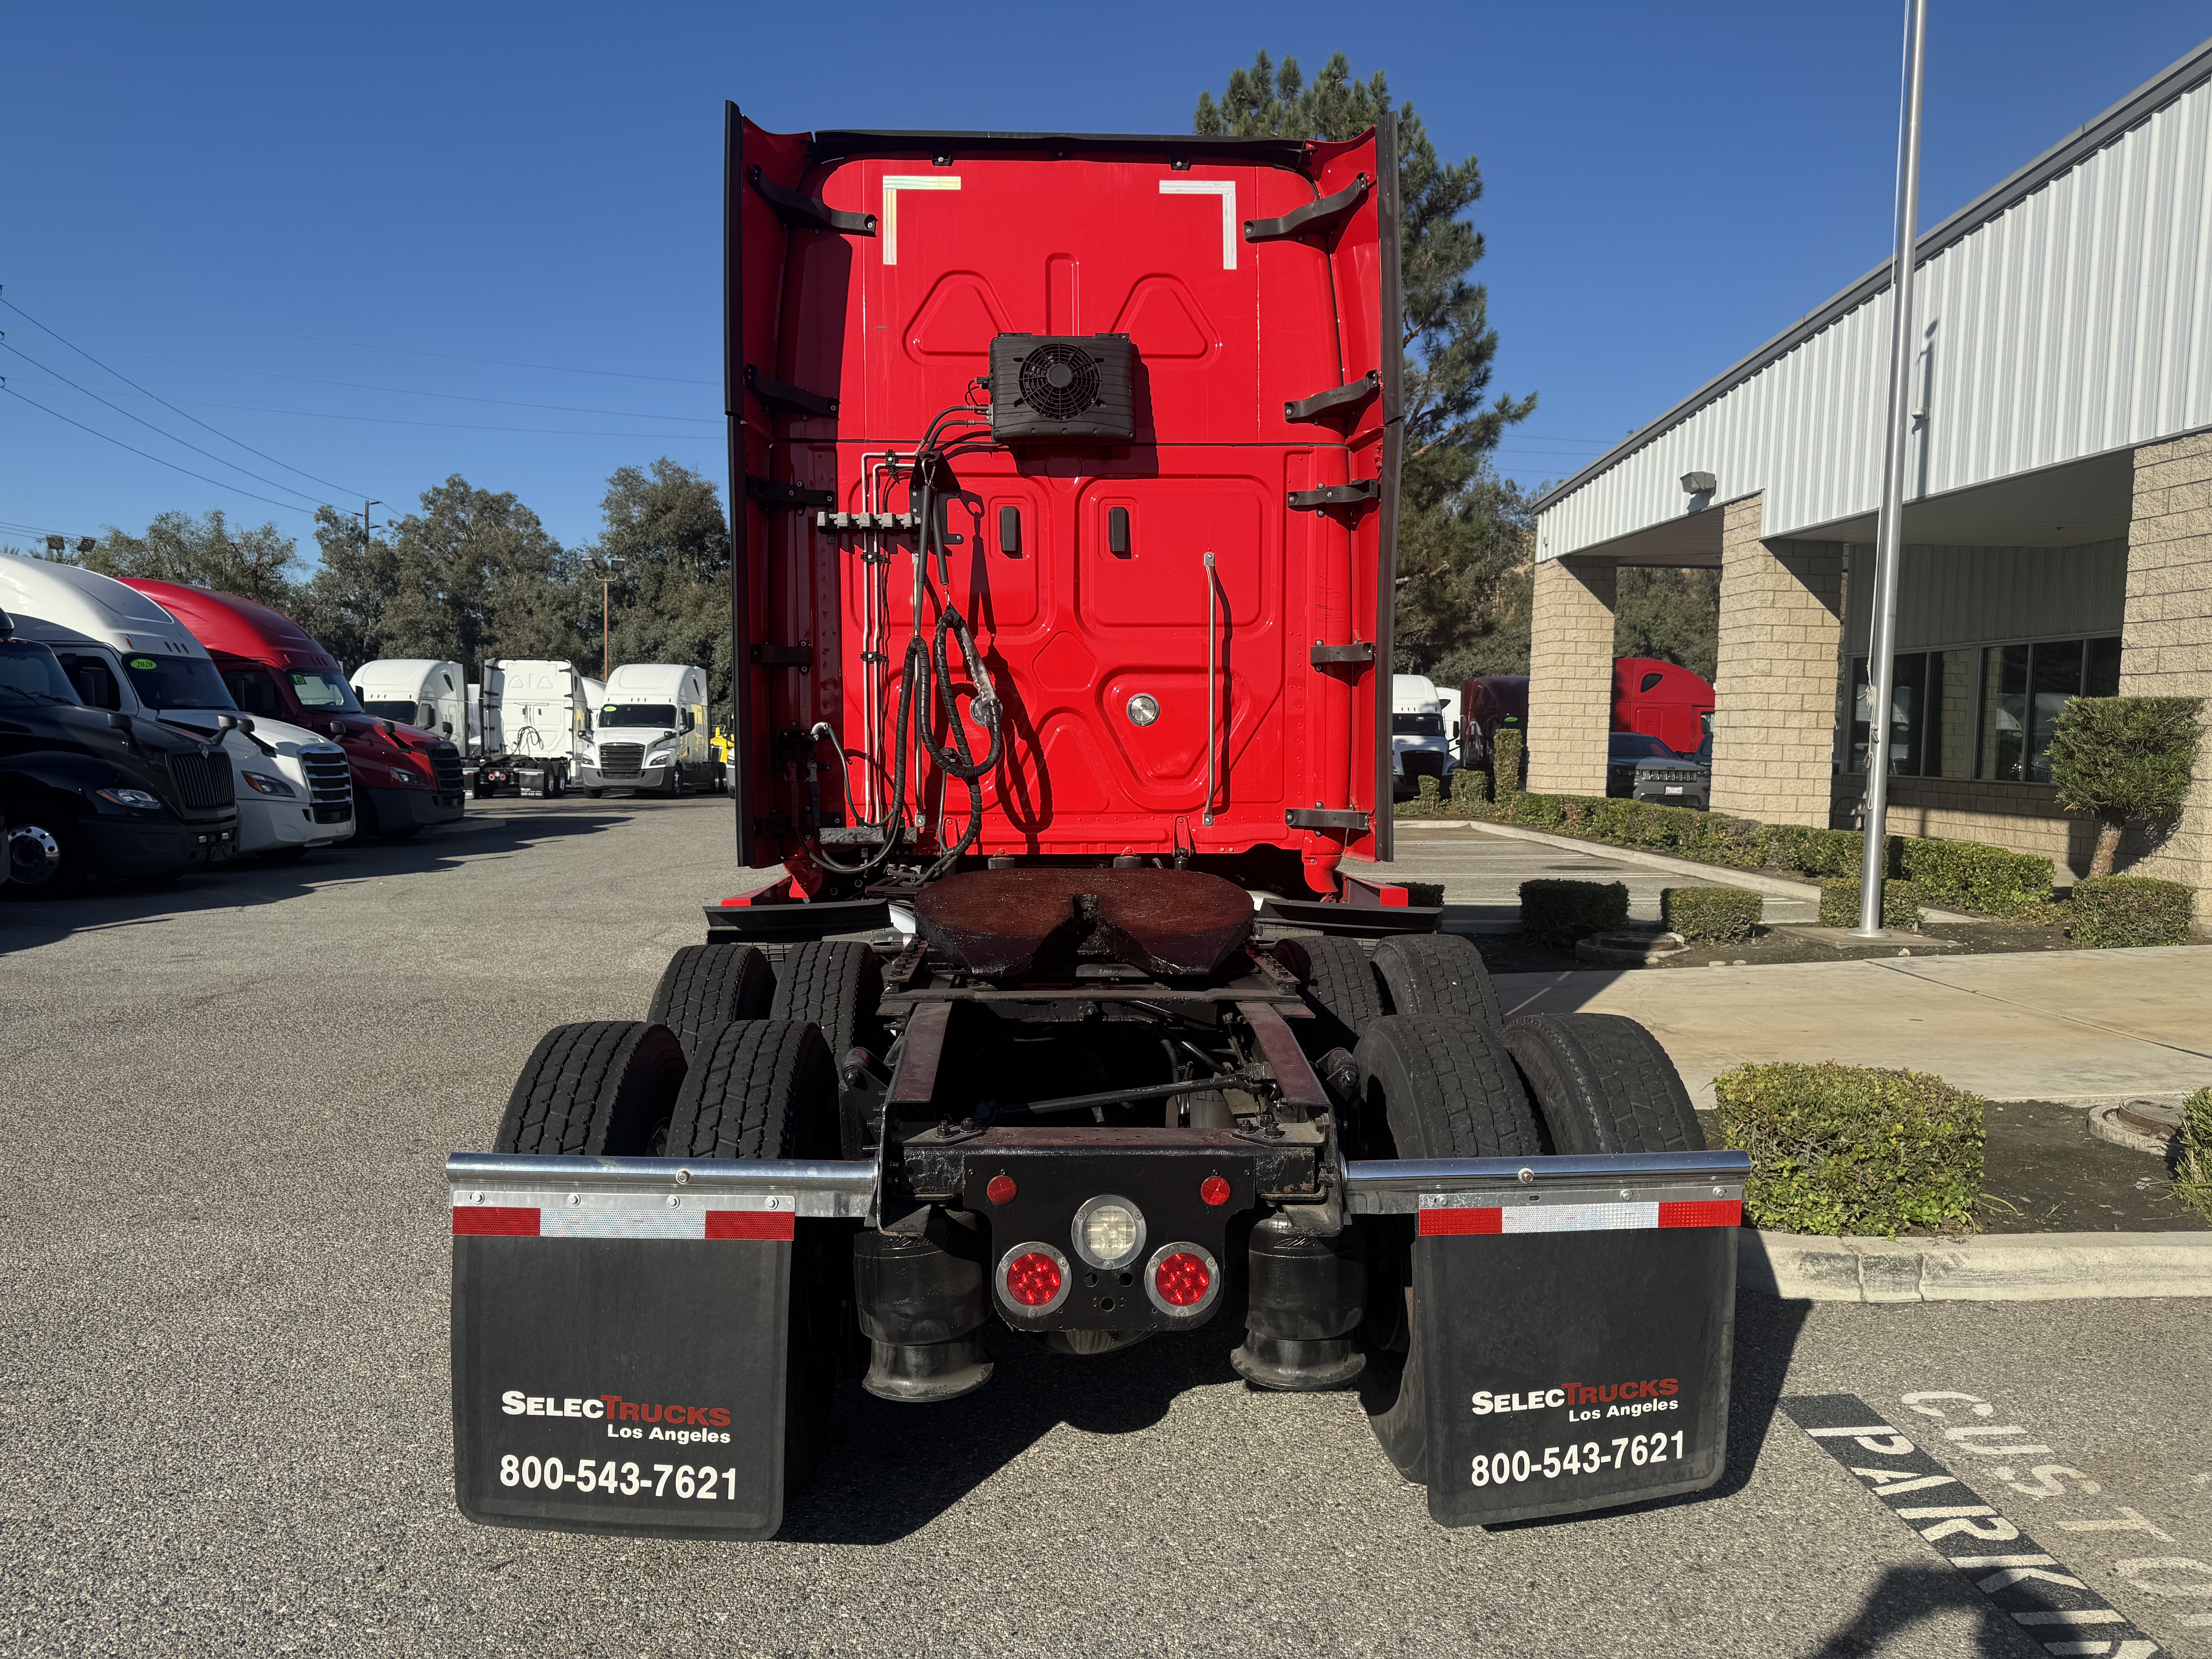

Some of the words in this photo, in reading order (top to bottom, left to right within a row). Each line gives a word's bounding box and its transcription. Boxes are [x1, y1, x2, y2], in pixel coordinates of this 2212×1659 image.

[501, 1390, 731, 1427] SELECTRUCKS
[1472, 1378, 1679, 1415] SELECTRUCKS
[1569, 1410, 1601, 1422] Los
[1606, 1398, 1679, 1417] Angeles
[607, 1424, 643, 1439] Los
[648, 1427, 731, 1445] Angeles
[1471, 1430, 1683, 1487] 800-543-7621
[500, 1455, 736, 1500] 800-543-7621
[1901, 1391, 2212, 1627] CUSTO
